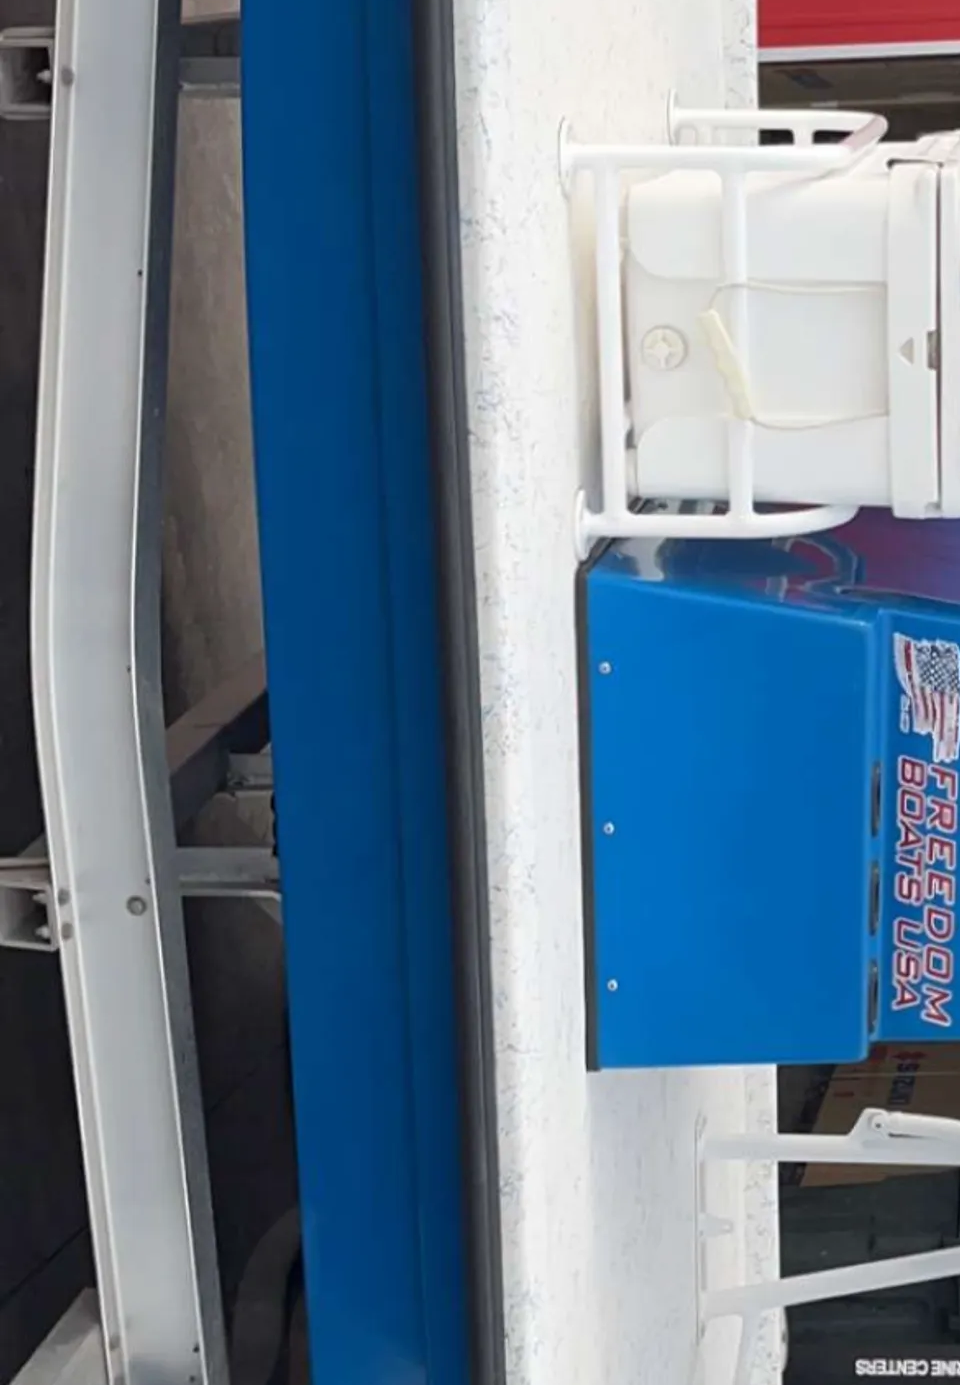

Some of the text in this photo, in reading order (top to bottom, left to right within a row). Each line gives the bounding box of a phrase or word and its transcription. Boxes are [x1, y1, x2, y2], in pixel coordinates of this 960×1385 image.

[891, 755, 926, 1011] BOATS USA
[921, 764, 958, 1026] FREEDOM
[854, 1358, 929, 1377] CENTERS
